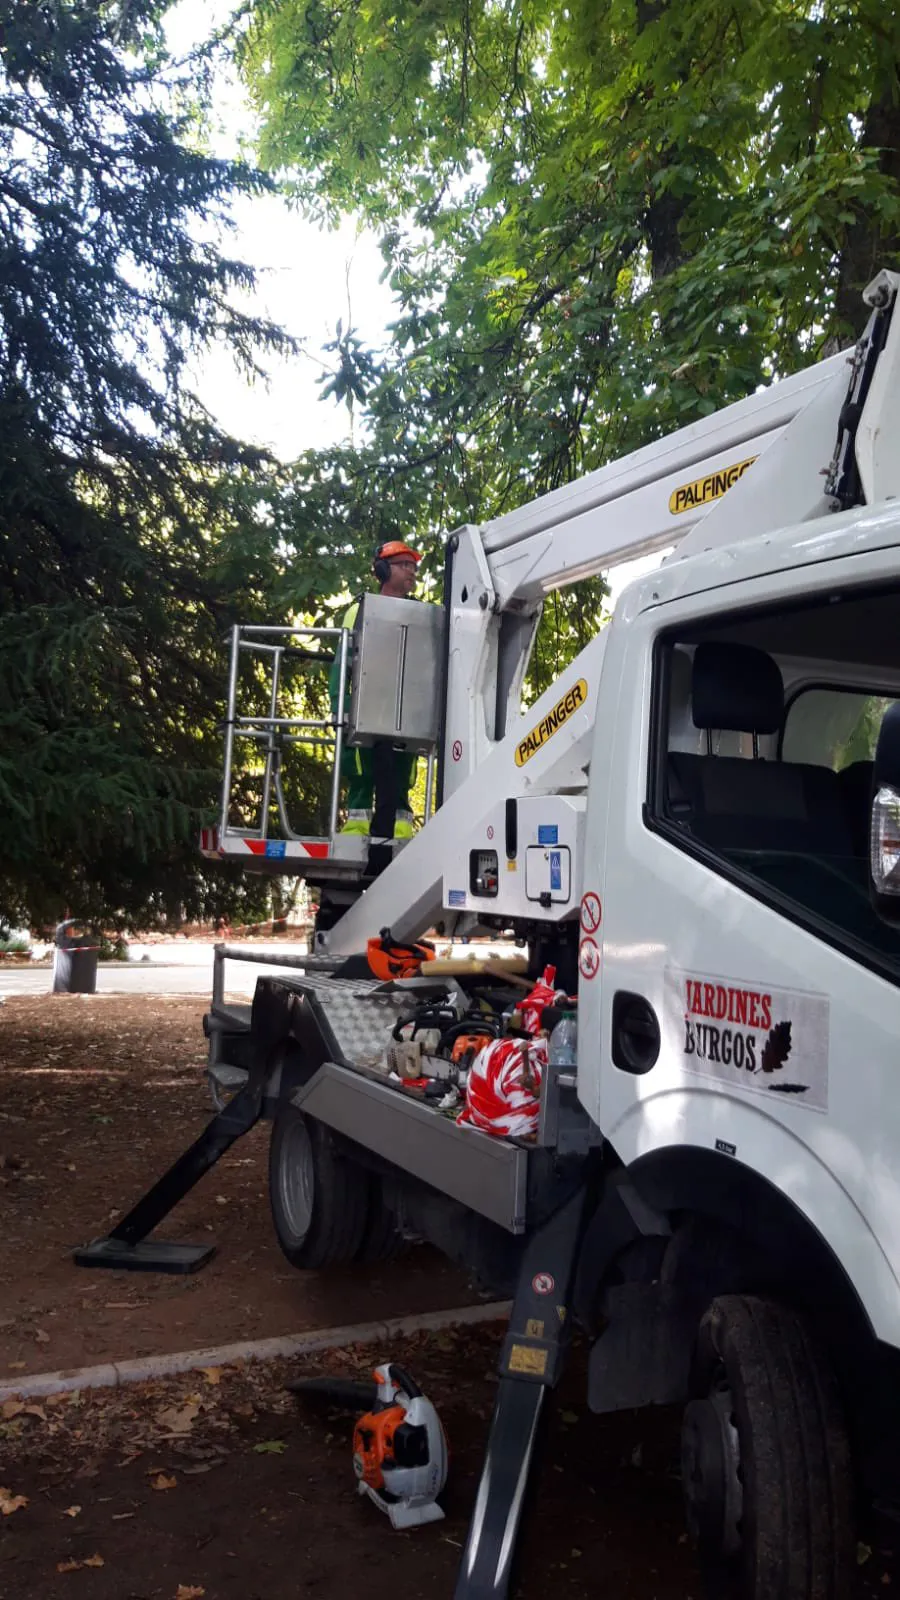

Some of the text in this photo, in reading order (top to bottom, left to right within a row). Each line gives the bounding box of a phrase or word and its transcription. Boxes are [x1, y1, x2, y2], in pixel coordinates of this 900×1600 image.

[518, 684, 583, 763] PALFINGER
[685, 979, 772, 1030] JARDINES
[684, 1019, 756, 1072] BURGOS
